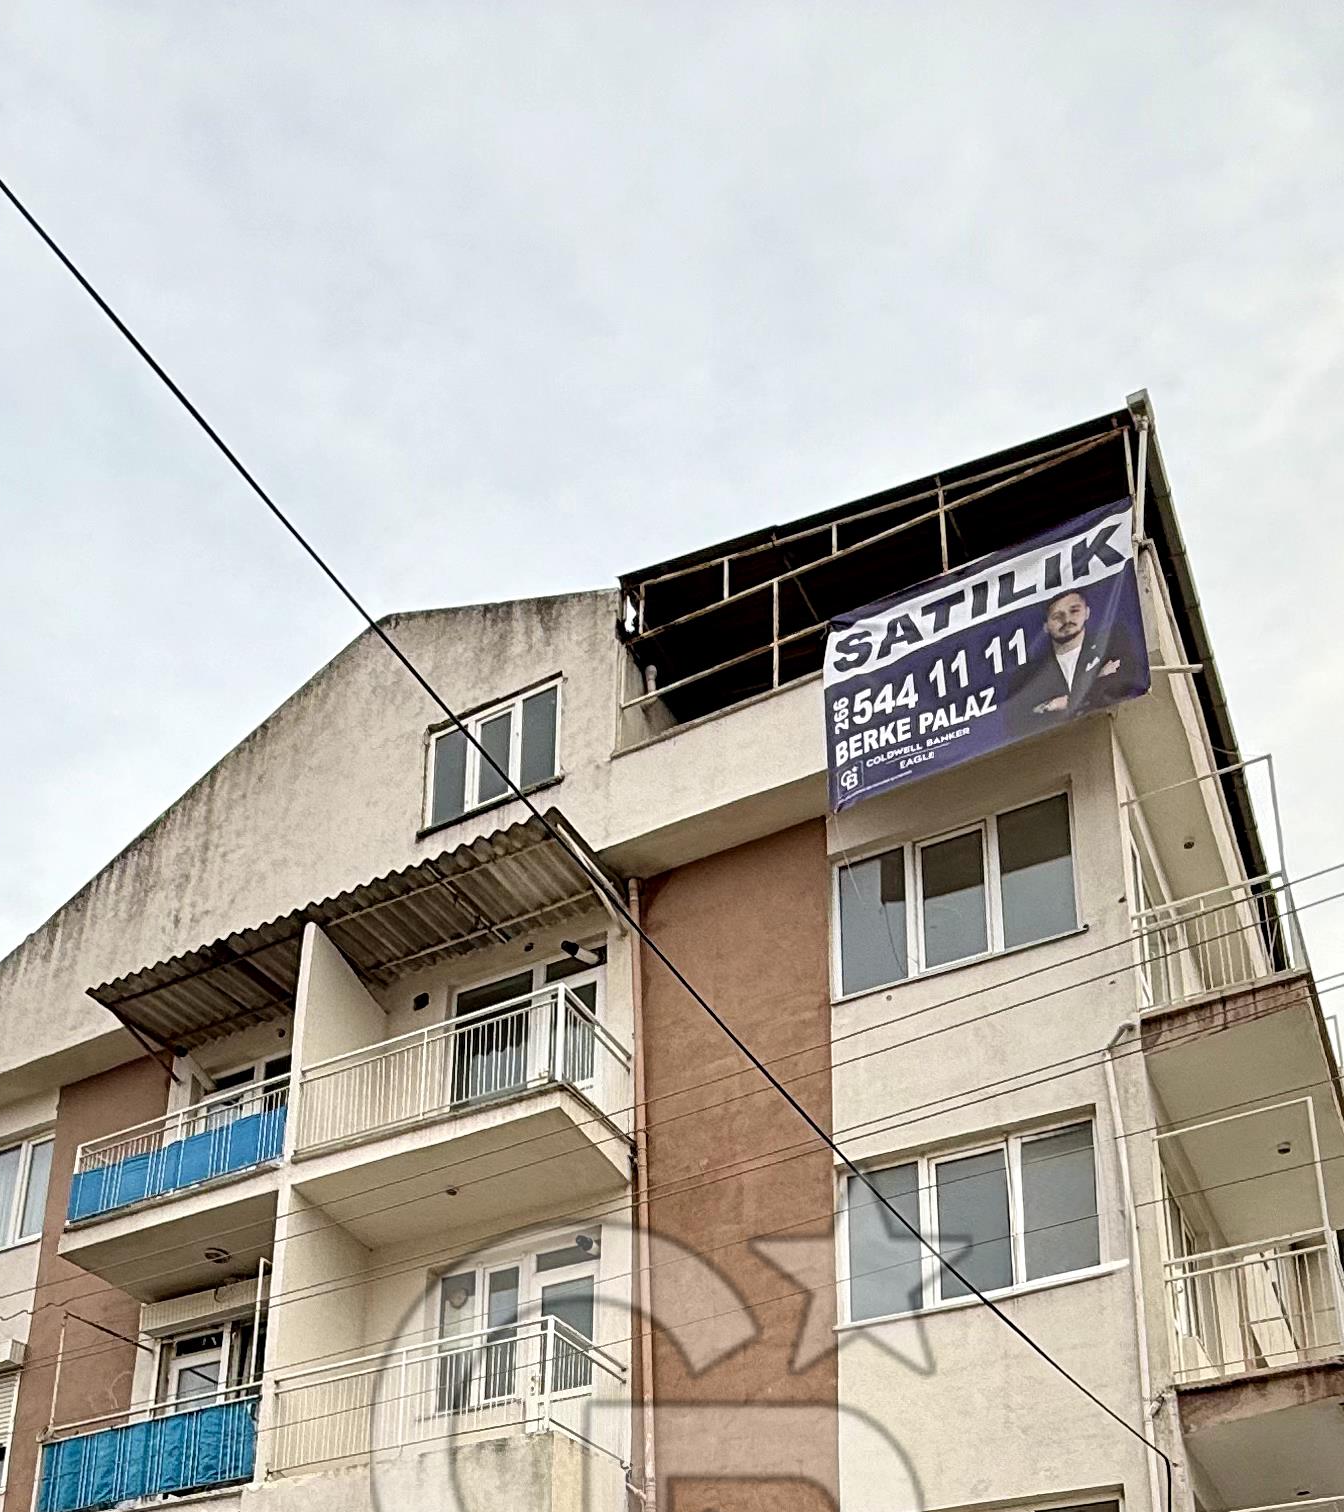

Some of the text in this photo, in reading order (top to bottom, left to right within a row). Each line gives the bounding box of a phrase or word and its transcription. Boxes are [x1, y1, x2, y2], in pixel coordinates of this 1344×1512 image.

[833, 522, 1126, 673] SATILIK
[833, 697, 849, 734] 266
[852, 628, 1027, 725] 544 11 11
[835, 687, 997, 767] BERKE PALAZ
[866, 727, 970, 768] COLDWELL BANKER
